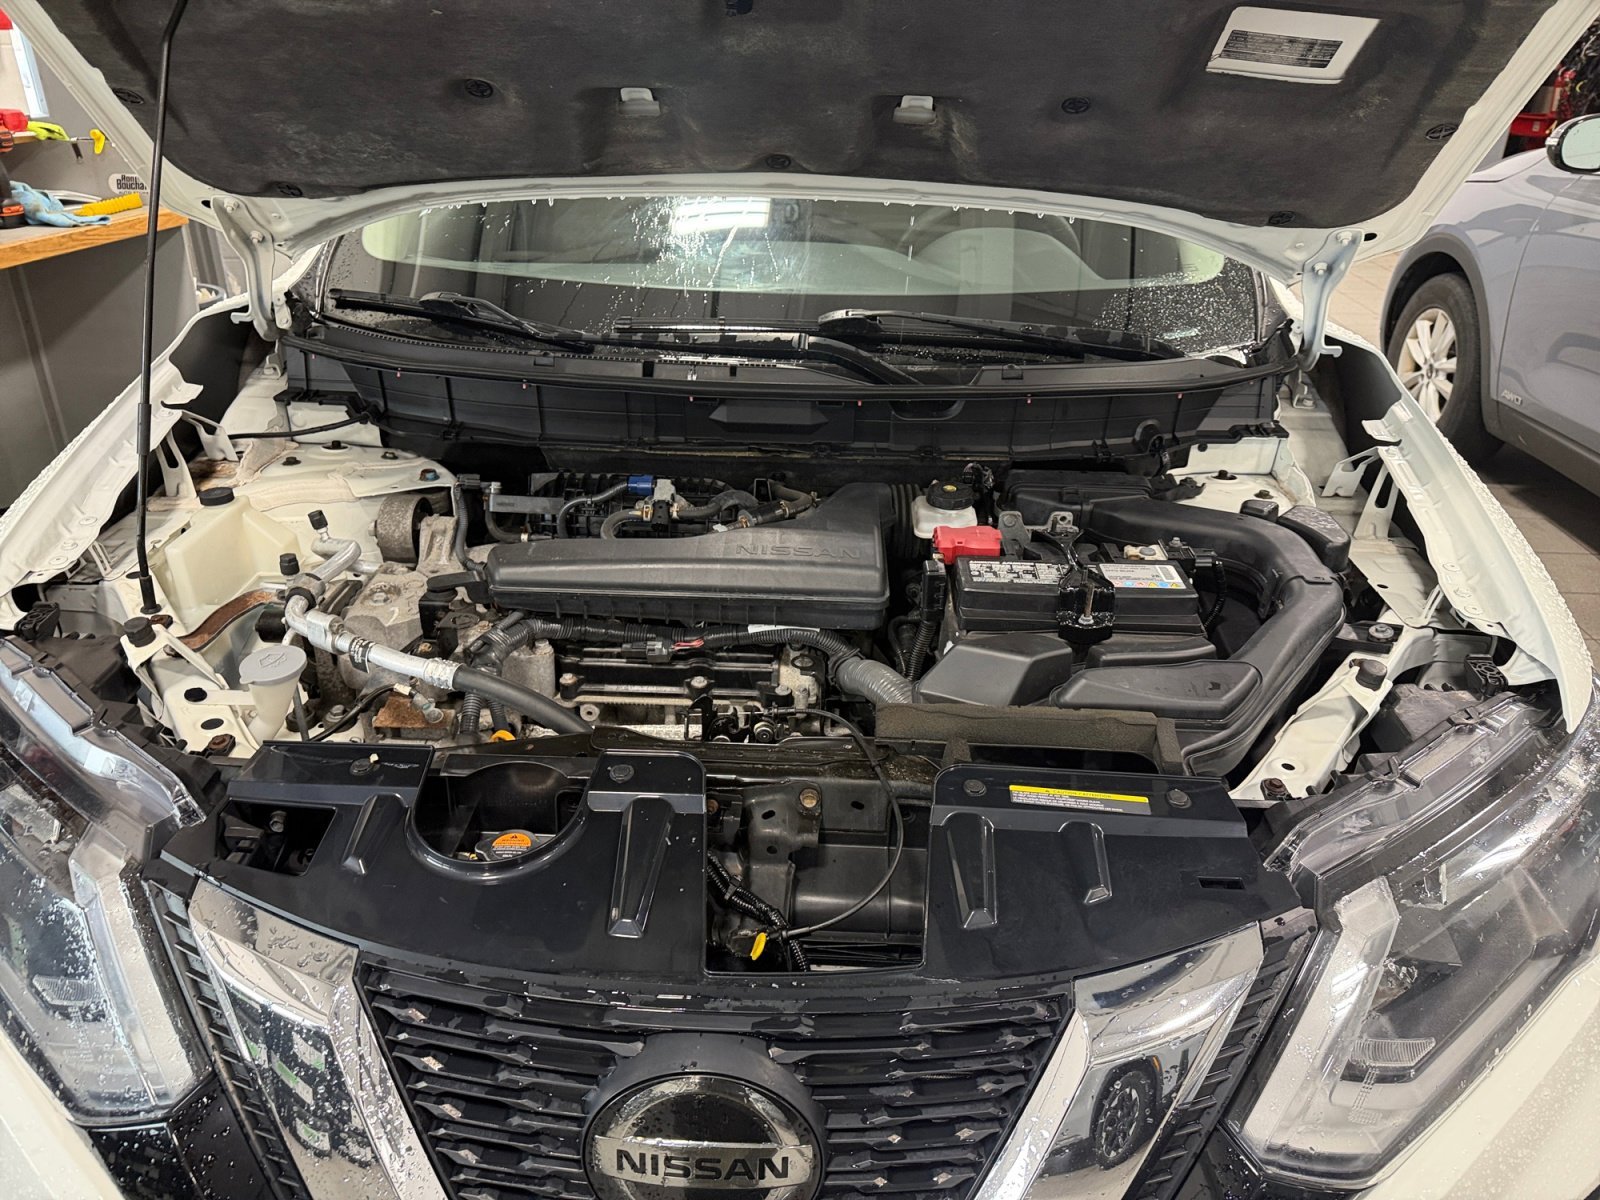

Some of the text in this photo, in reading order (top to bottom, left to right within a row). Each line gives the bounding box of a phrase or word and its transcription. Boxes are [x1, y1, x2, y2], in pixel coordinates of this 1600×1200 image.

[116, 177, 147, 190] Boucha
[736, 544, 860, 559] NISSAN
[616, 1149, 789, 1180] NISSAN
